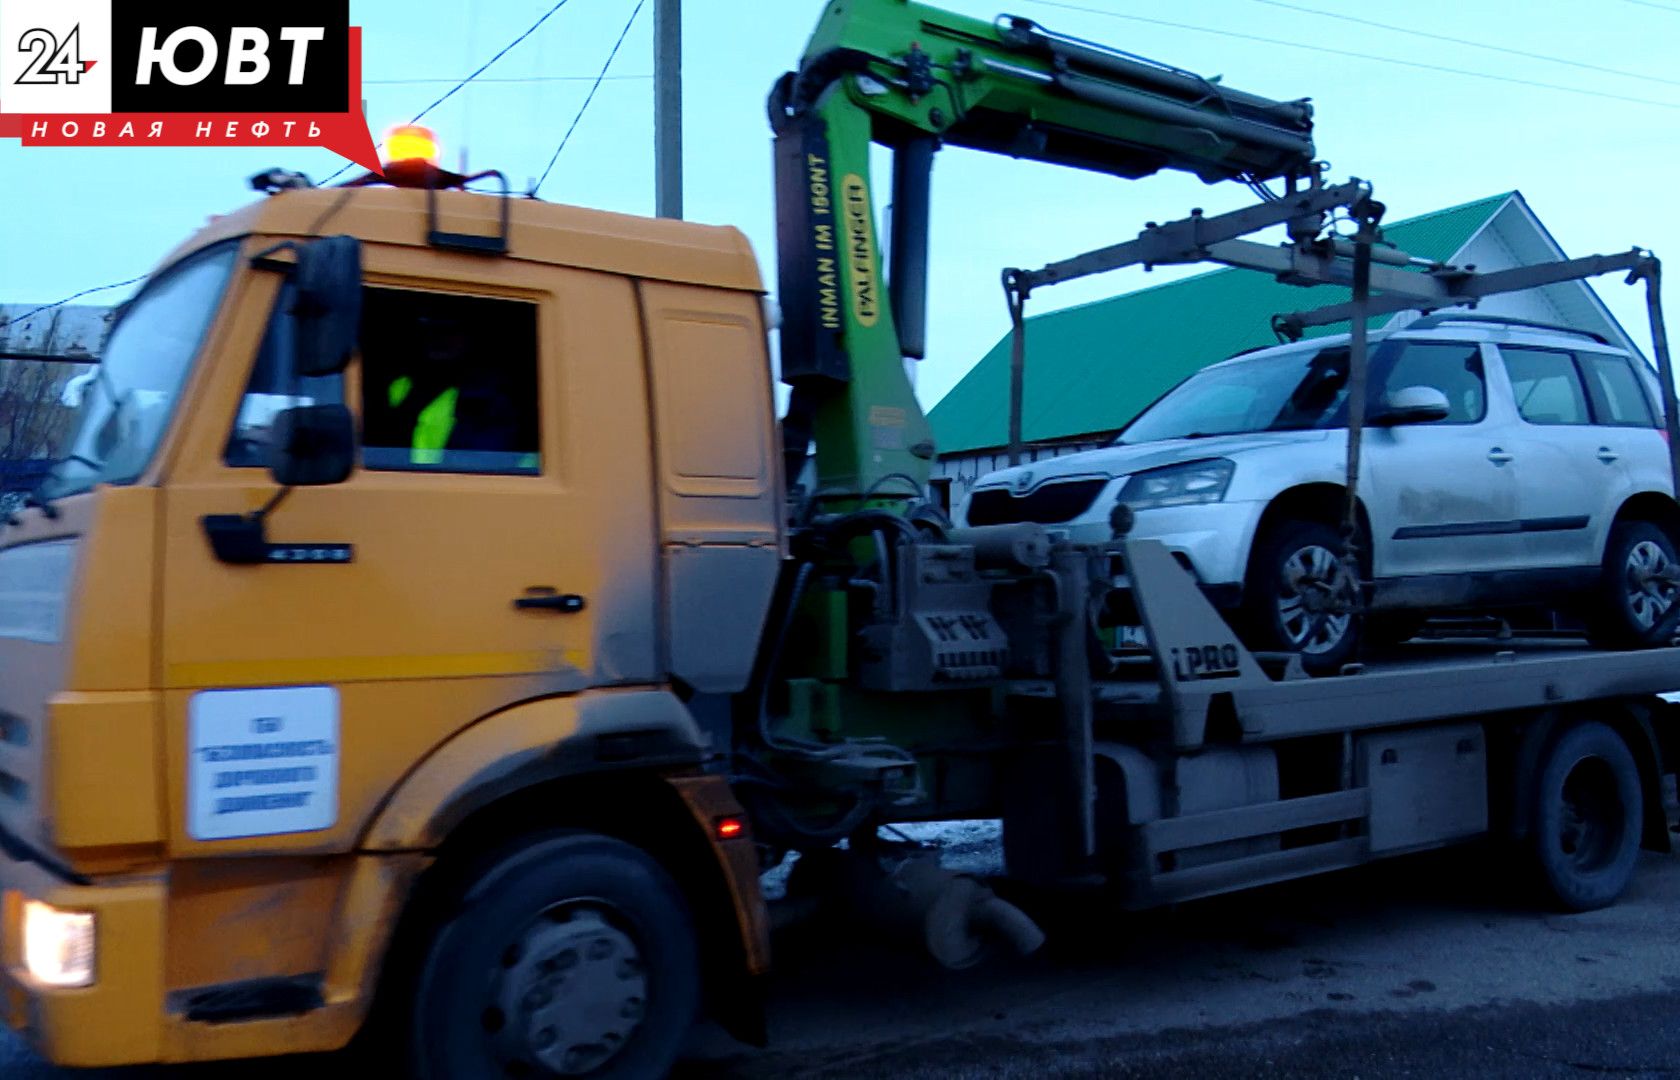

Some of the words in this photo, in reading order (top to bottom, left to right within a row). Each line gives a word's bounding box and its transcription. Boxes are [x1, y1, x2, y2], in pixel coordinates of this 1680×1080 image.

[814, 224, 833, 250] IM
[848, 184, 875, 318] PALFINGER
[816, 256, 840, 329] INMAN
